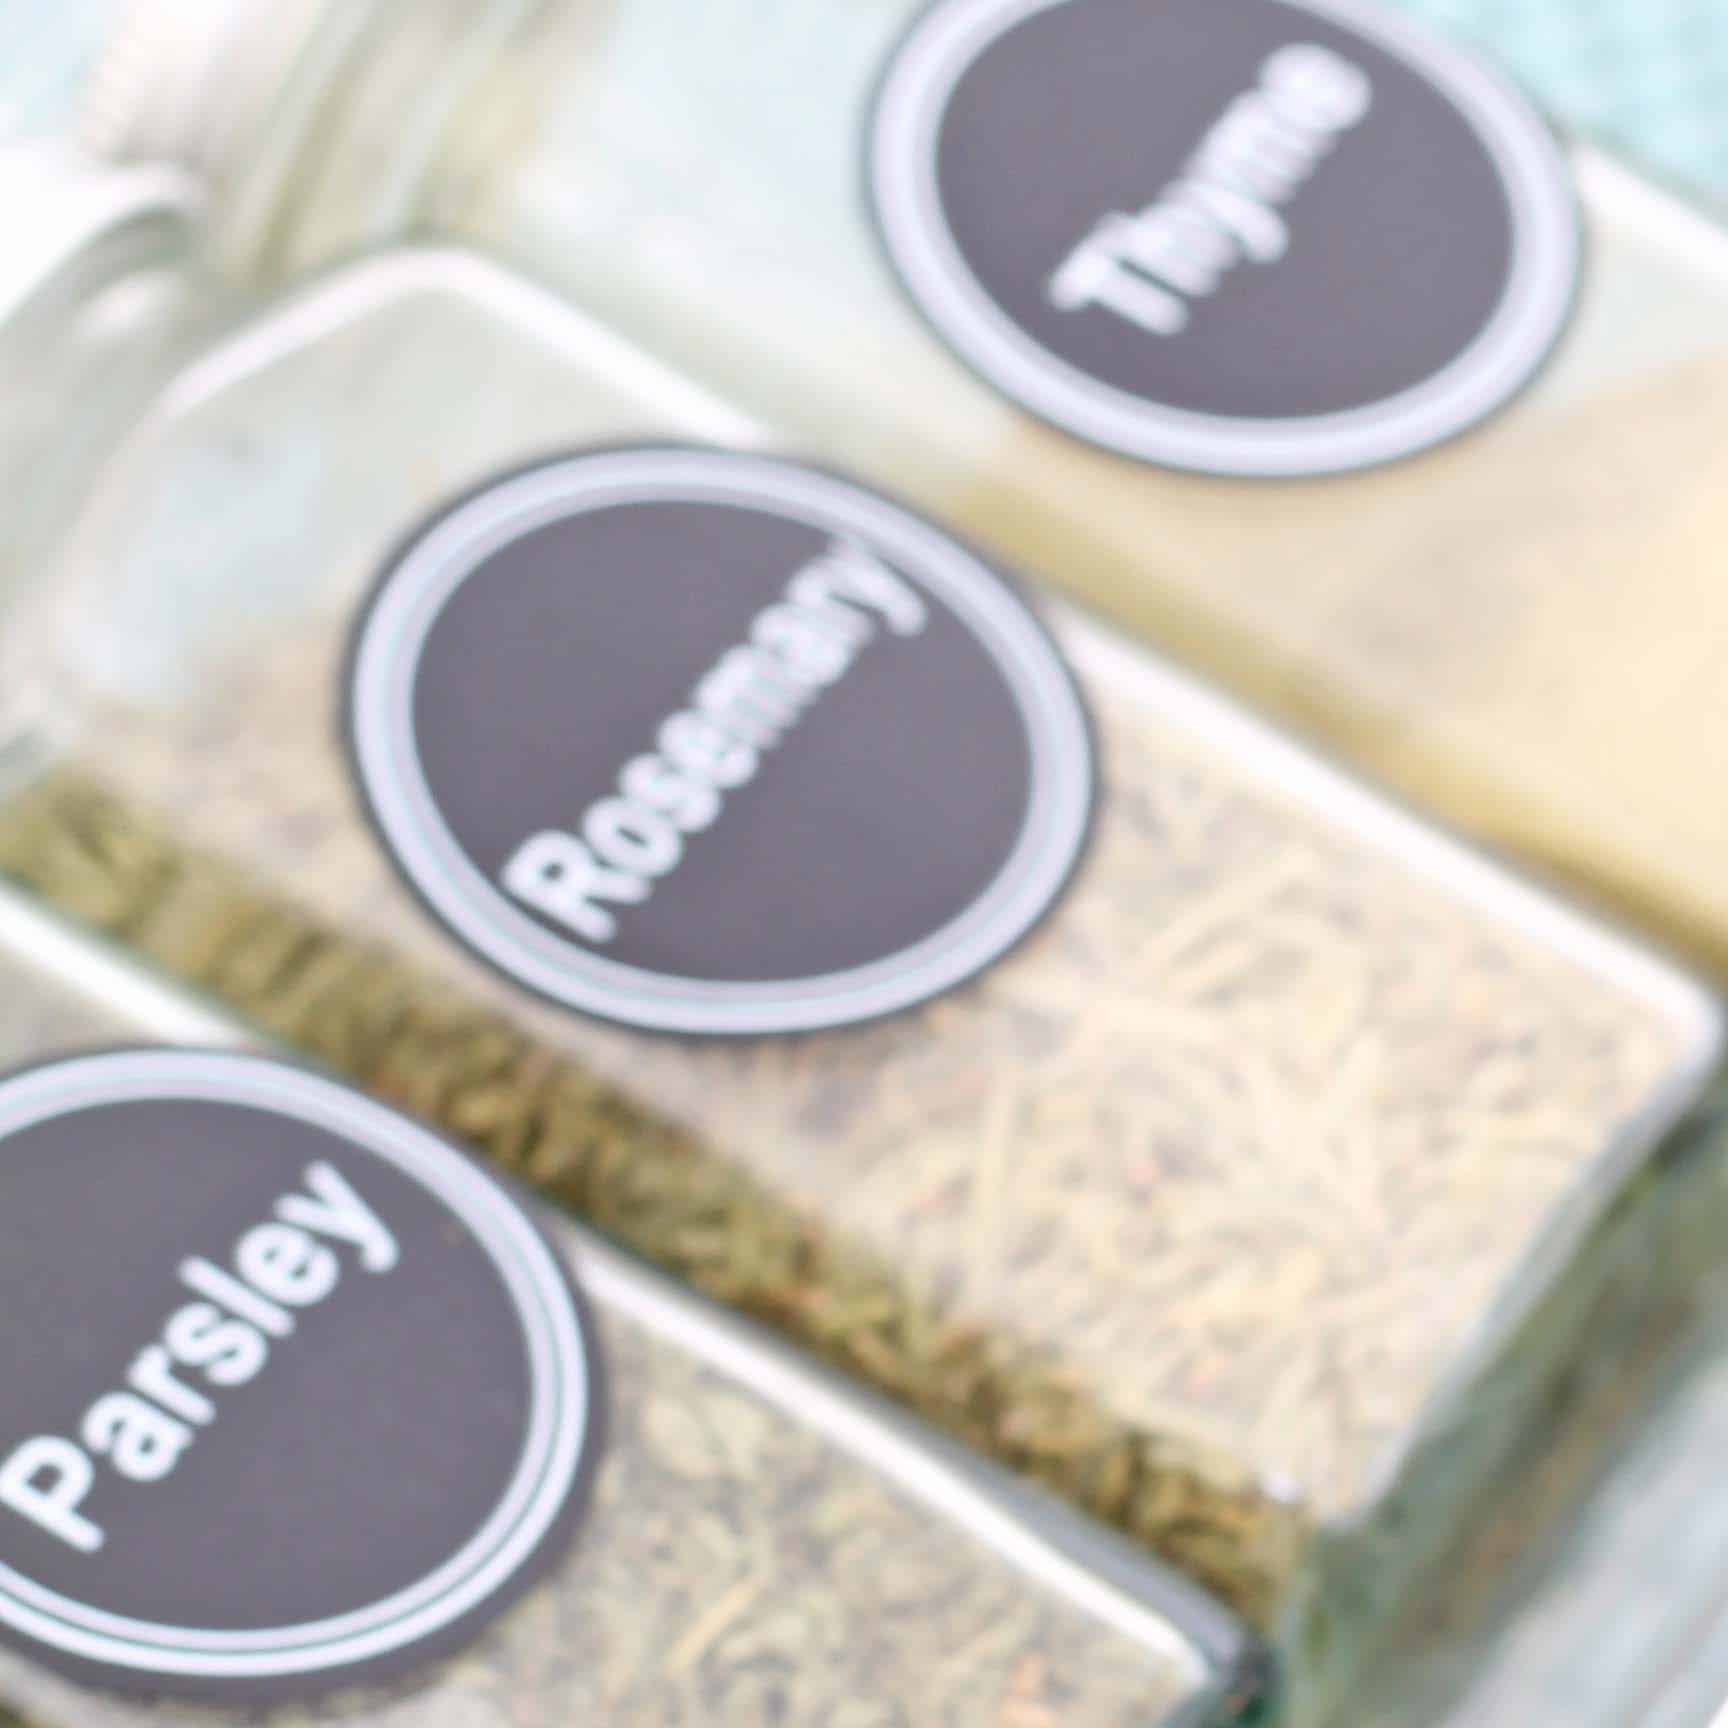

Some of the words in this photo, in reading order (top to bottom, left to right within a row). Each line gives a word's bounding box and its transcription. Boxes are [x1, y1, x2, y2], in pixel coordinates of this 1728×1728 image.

[1046, 42, 1374, 338] Thyme
[502, 531, 928, 942] Rosemary
[0, 1161, 399, 1553] Parsley
